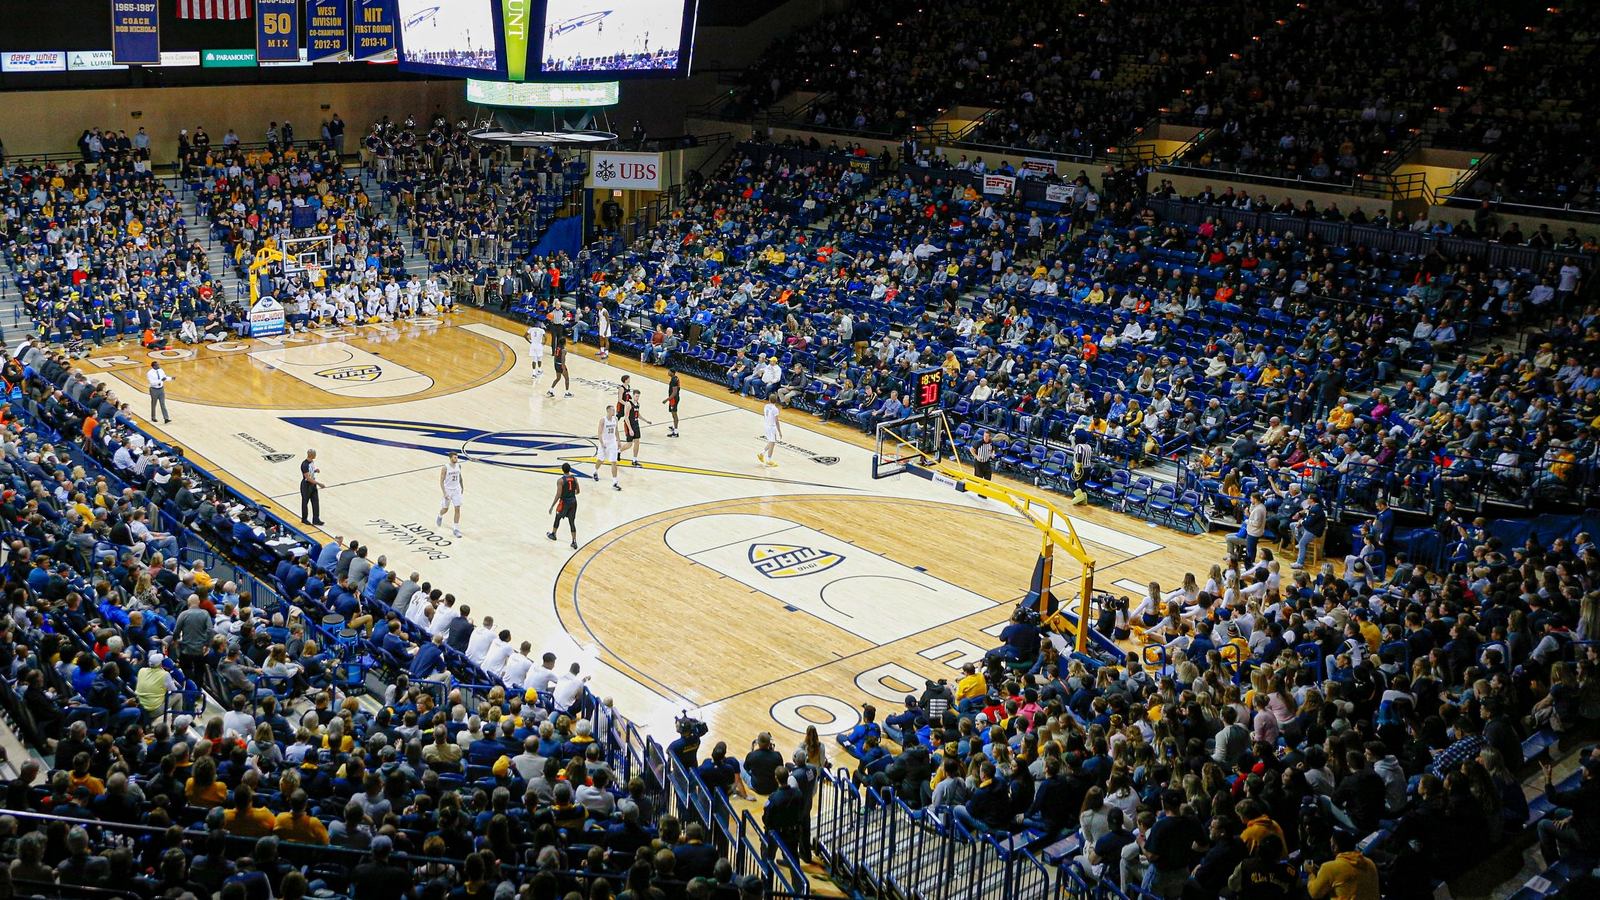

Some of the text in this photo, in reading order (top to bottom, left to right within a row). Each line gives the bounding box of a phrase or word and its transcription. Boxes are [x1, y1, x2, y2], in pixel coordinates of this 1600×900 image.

[115, 3, 155, 12] 1965-1987
[317, 6, 336, 16] WEST
[363, 8, 383, 22] NIT
[122, 17, 150, 25] COACH
[263, 13, 291, 34] 50
[312, 17, 342, 27] DIVISION
[309, 29, 345, 37] CO-CHAMPIONS
[354, 25, 392, 34] FIRST ROUND
[313, 39, 341, 49] 2012-13
[360, 37, 387, 47] 2013-14
[10, 53, 58, 62] dave white
[620, 162, 656, 180] UBS
[985, 176, 1013, 189] ESPN
[921, 371, 941, 386] 18:45
[921, 383, 938, 405] 30
[400, 522, 452, 547] COURT
[411, 546, 450, 560] Bob
